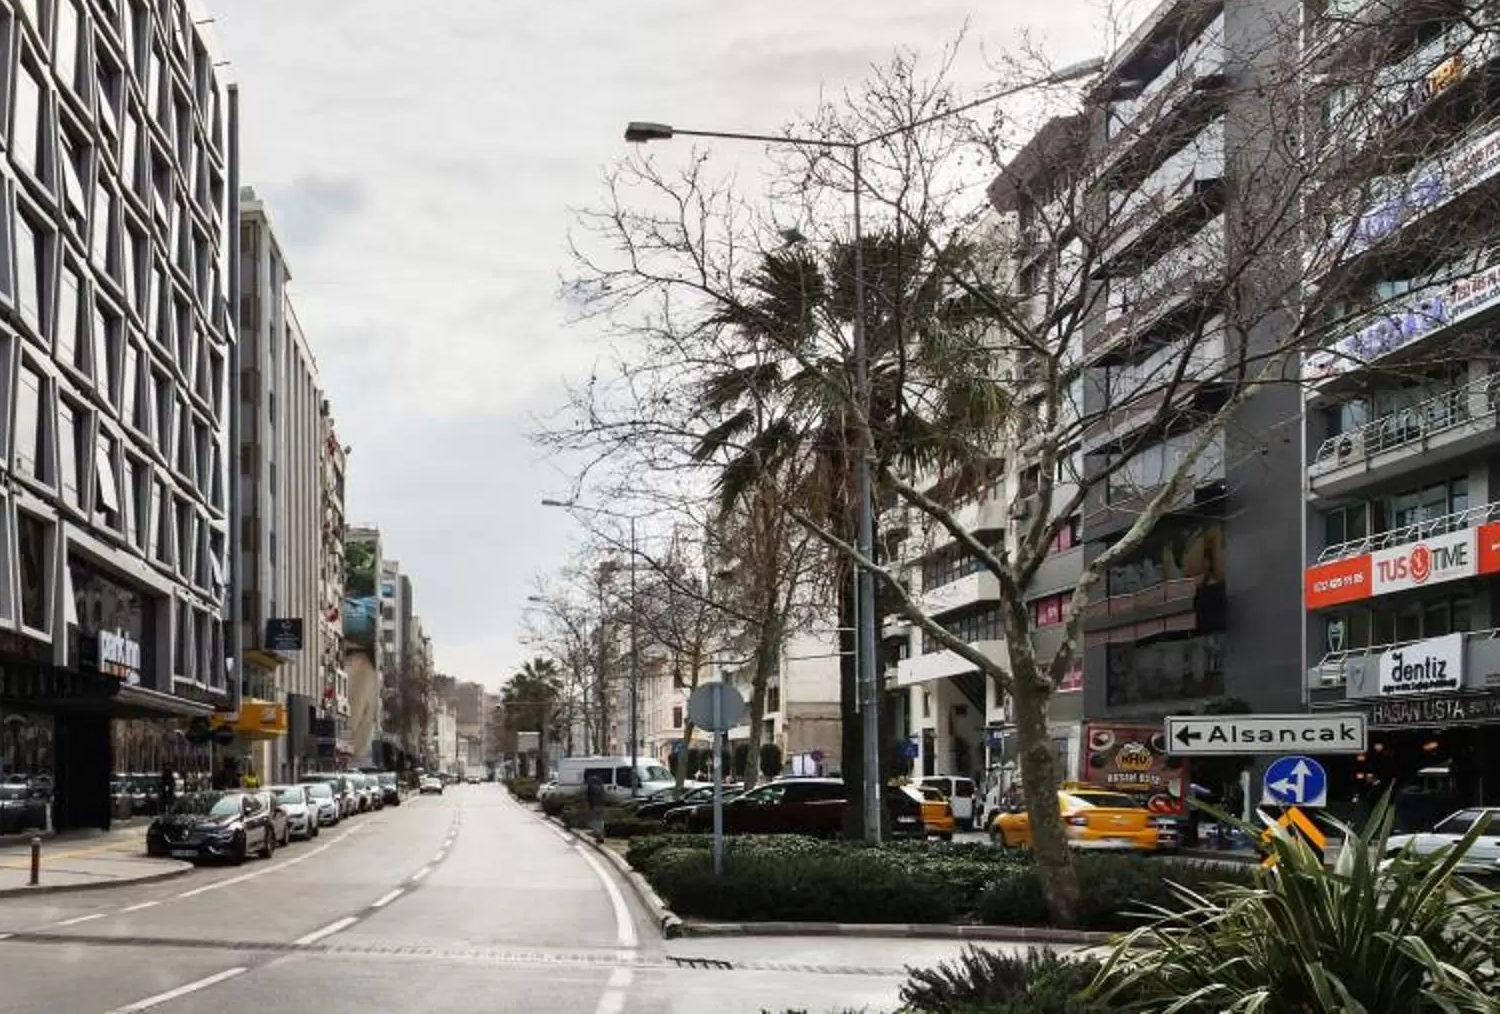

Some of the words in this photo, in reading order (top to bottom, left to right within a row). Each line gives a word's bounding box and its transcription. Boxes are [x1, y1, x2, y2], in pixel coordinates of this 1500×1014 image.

[1377, 557, 1408, 583] TUS
[1432, 542, 1468, 569] TIME
[1391, 652, 1448, 682] dentiz
[1373, 701, 1420, 723] HASAN
[1424, 698, 1465, 720] USTA
[1208, 723, 1356, 743] Alsancak
